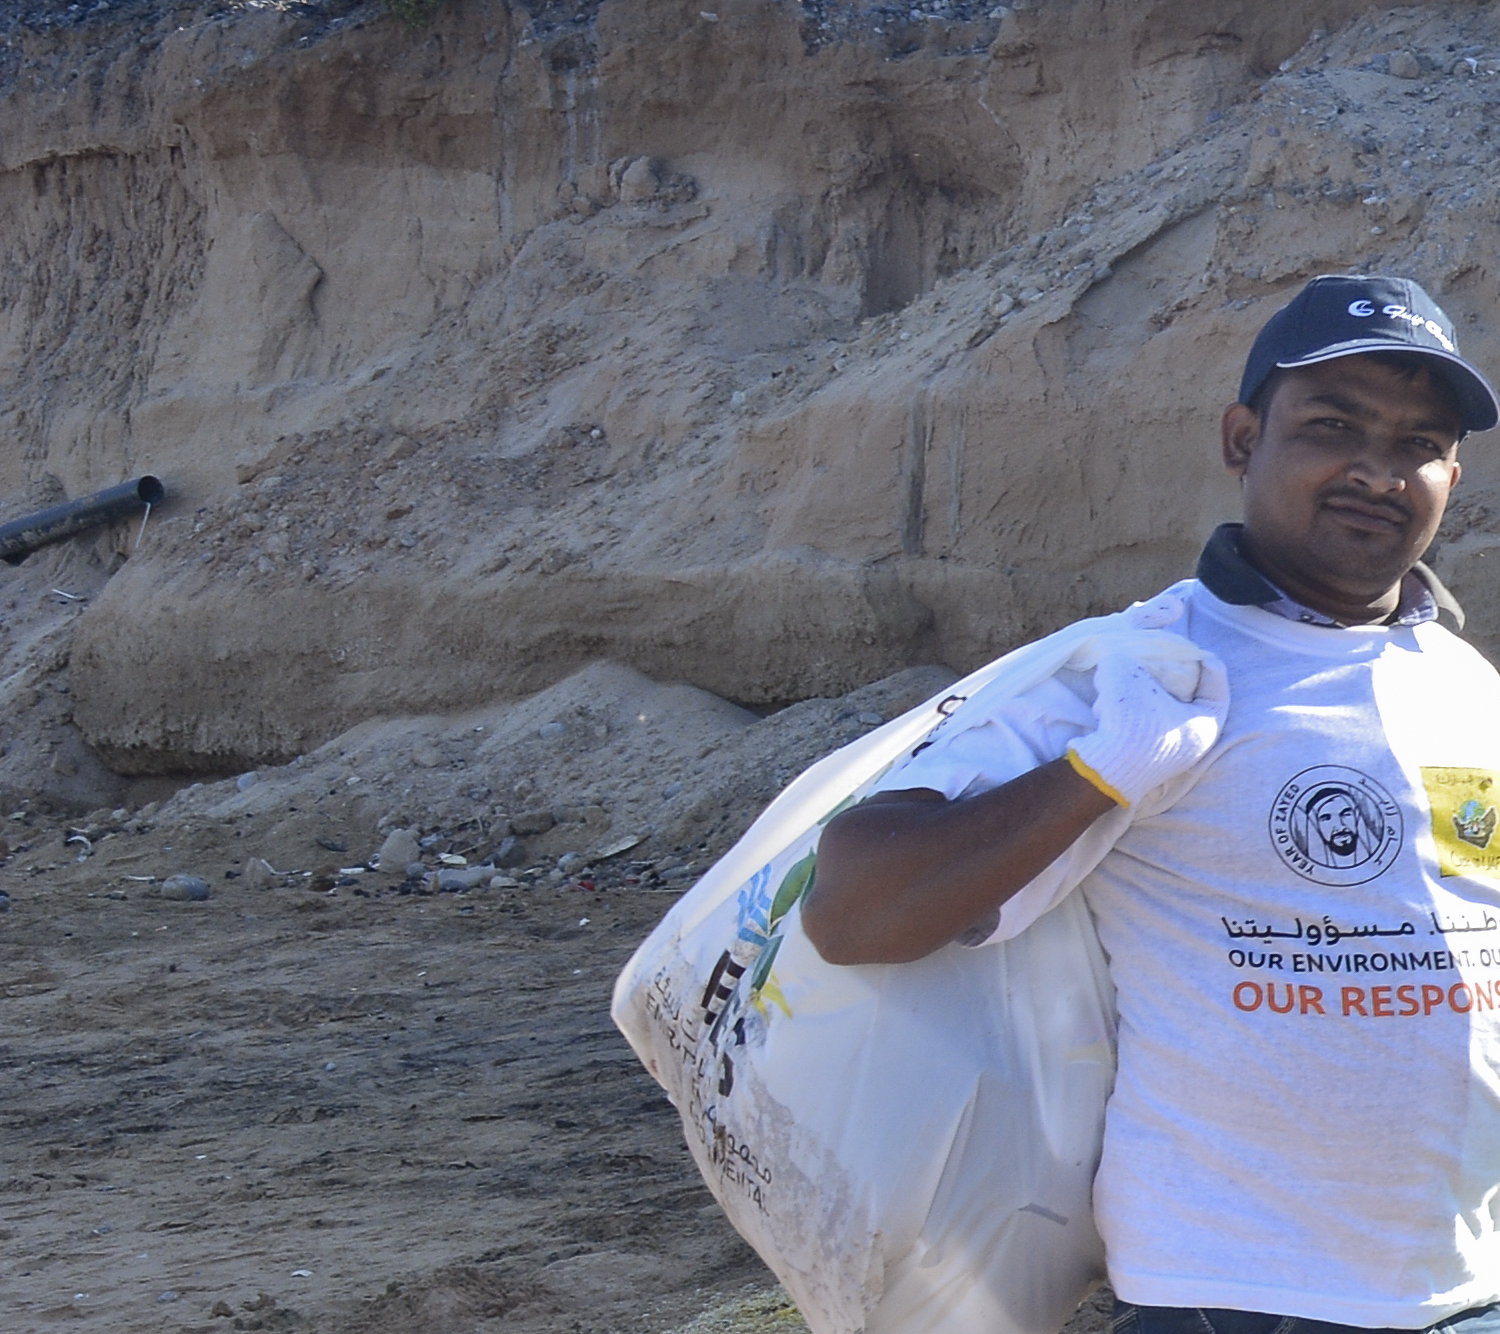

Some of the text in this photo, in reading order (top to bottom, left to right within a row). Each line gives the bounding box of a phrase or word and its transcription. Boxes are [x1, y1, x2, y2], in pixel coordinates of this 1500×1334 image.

[1275, 783, 1315, 875] YEAR OF ZAYED
[1221, 915, 1416, 946] مسؤوليتنا
[1228, 949, 1284, 970] OUR
[1292, 950, 1476, 973] ENVIRONMENT.
[1233, 981, 1326, 1016] OUR
